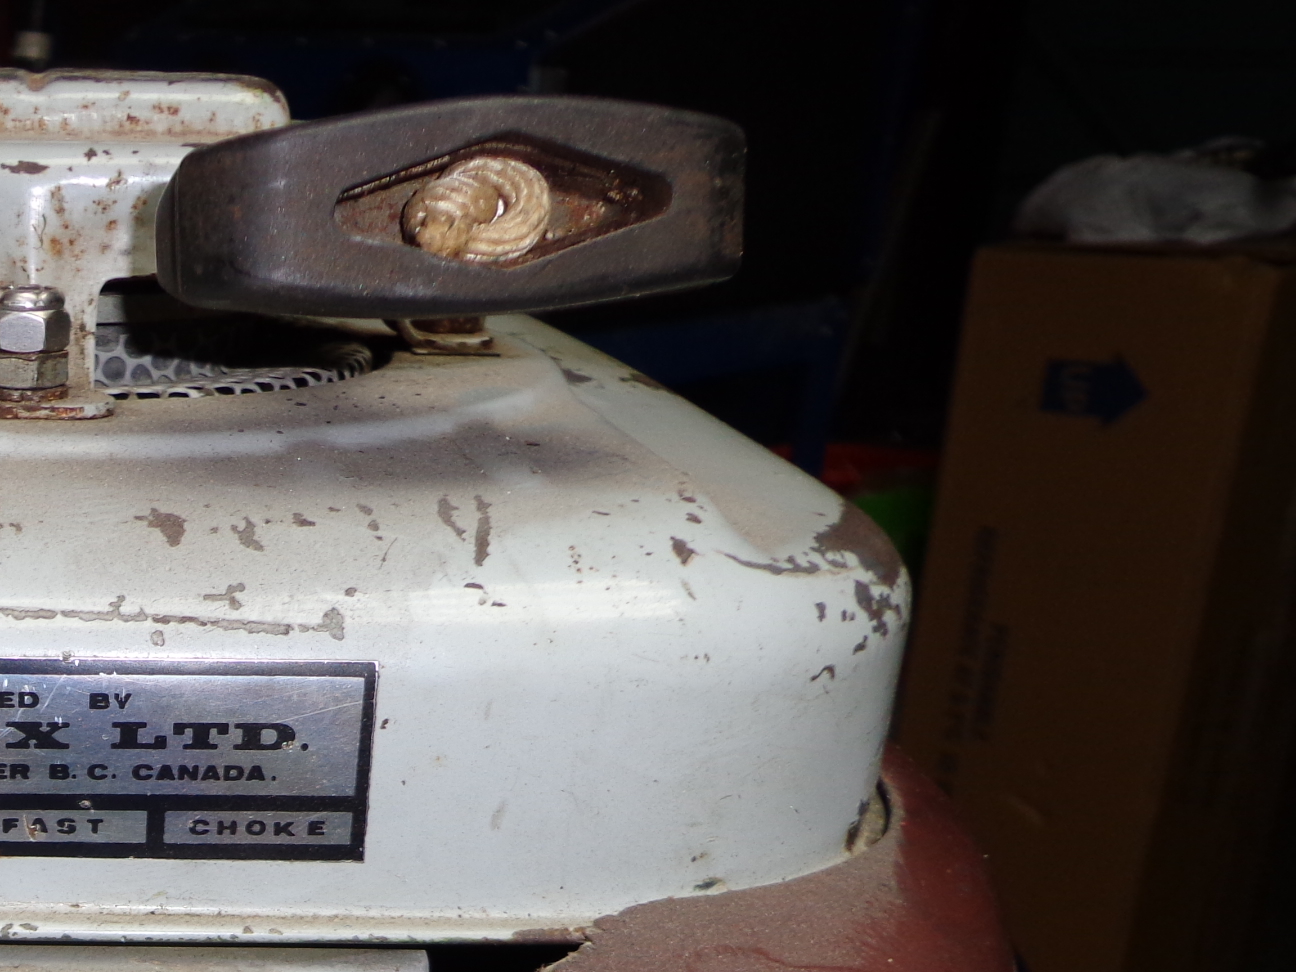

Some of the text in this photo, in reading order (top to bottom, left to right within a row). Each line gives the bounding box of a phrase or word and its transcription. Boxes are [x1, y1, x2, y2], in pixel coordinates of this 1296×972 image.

[89, 691, 132, 711] BY
[111, 721, 310, 752] LTD.
[131, 764, 277, 782] CANADA.
[2, 816, 104, 836] FAST
[188, 818, 328, 838] CHOKE
